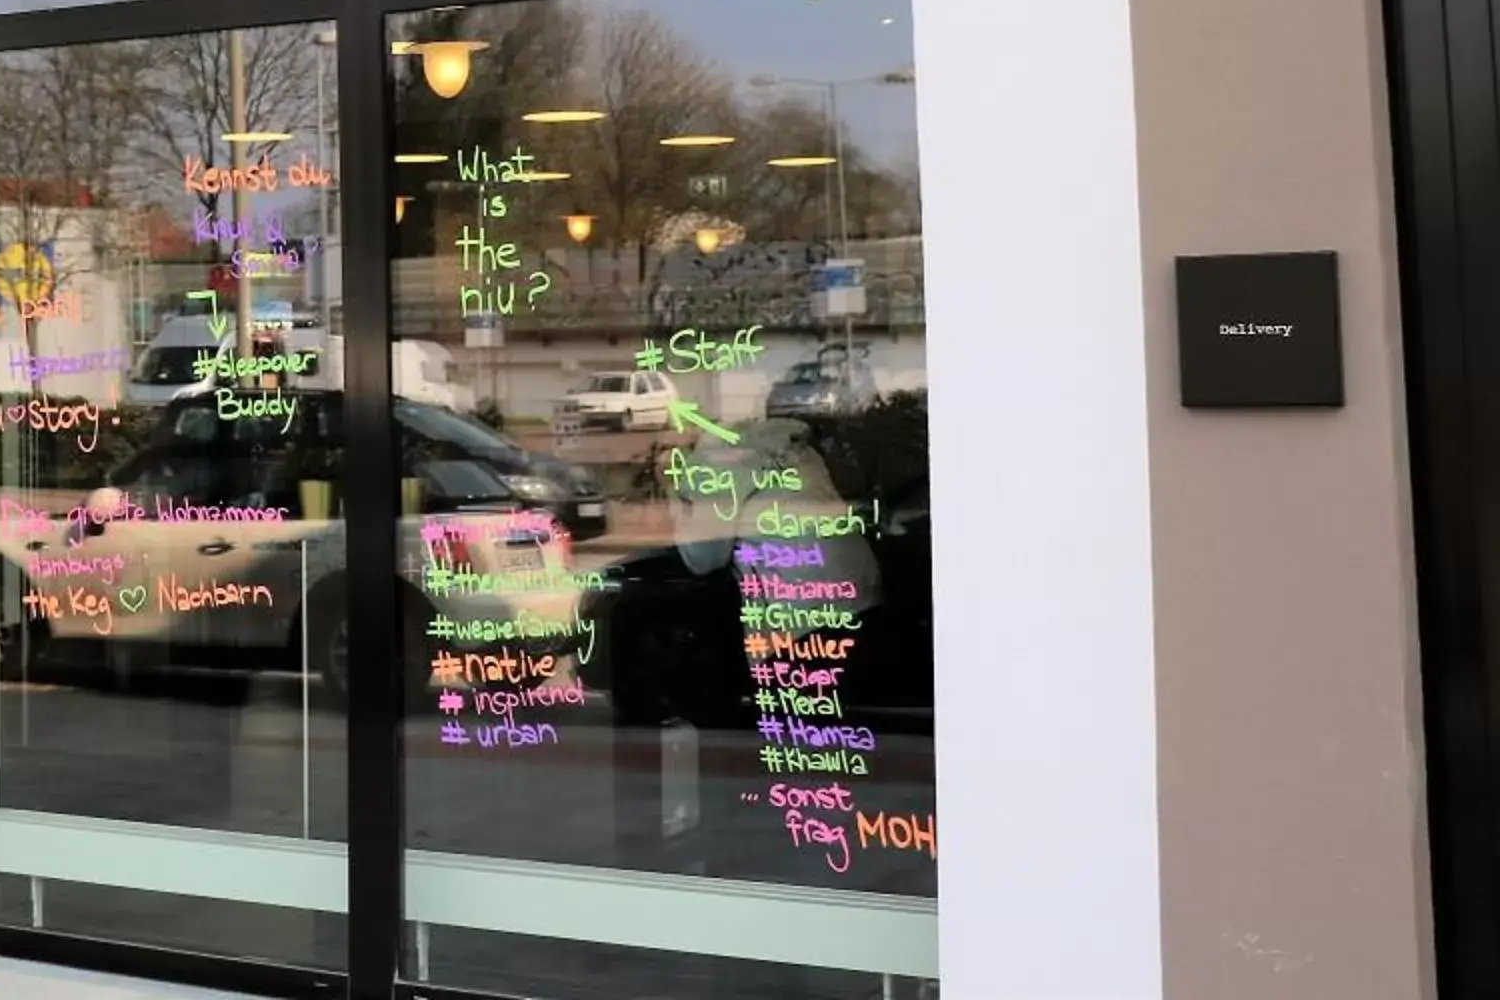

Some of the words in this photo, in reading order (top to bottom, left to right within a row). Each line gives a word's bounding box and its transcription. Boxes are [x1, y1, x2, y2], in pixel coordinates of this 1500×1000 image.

[184, 152, 278, 195] Kennst
[457, 145, 535, 182] What
[480, 183, 507, 217] is
[455, 225, 521, 274] the
[1219, 323, 1293, 337] Delivery
[192, 348, 317, 384] #sleepover
[215, 386, 299, 434] Buddy
[664, 447, 738, 521] frag
[752, 467, 803, 491] uns
[23, 590, 65, 619] the
[67, 586, 112, 635] Keg
[158, 573, 274, 612] Nachbarn
[431, 646, 557, 684] #native
[760, 744, 869, 775] #Khawla
[785, 808, 850, 873] frag
